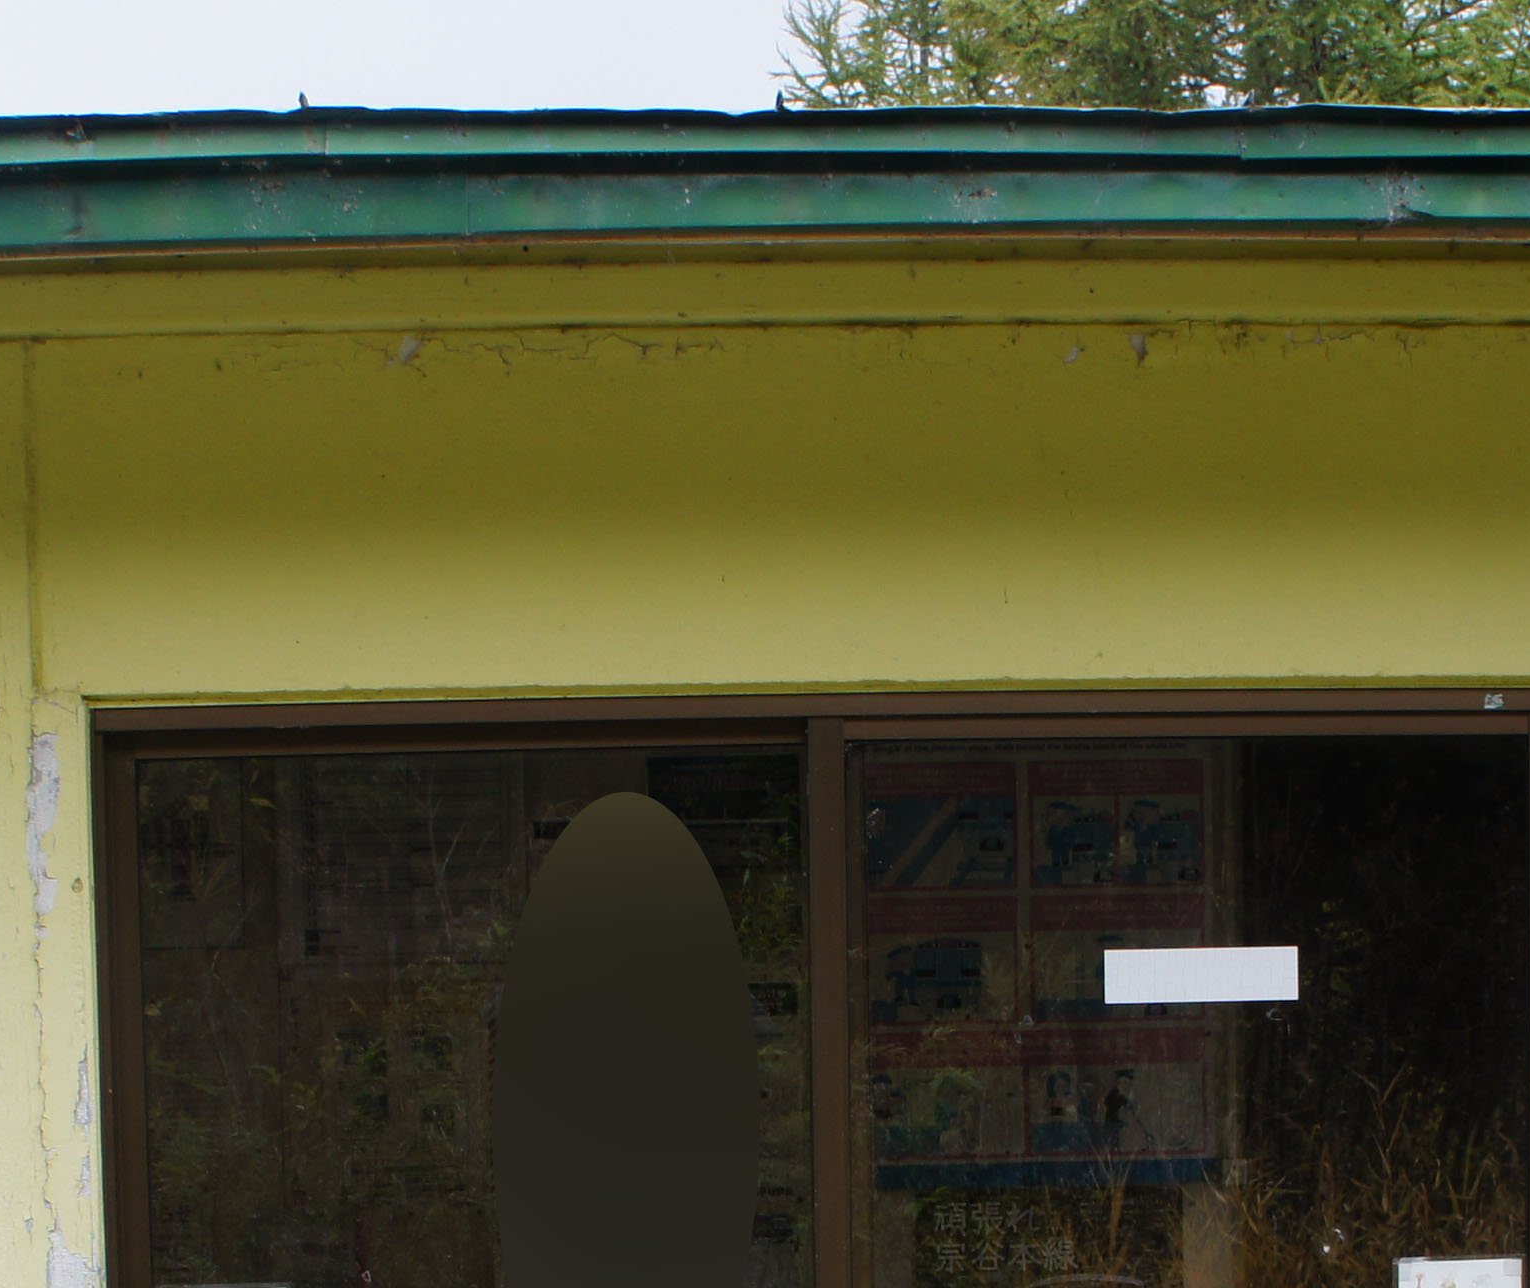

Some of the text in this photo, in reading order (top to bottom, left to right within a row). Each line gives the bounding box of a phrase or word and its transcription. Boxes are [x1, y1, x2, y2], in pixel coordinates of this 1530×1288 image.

[933, 1201, 1041, 1236] 頑張れ
[935, 1238, 1079, 1272] 宗谷本線
